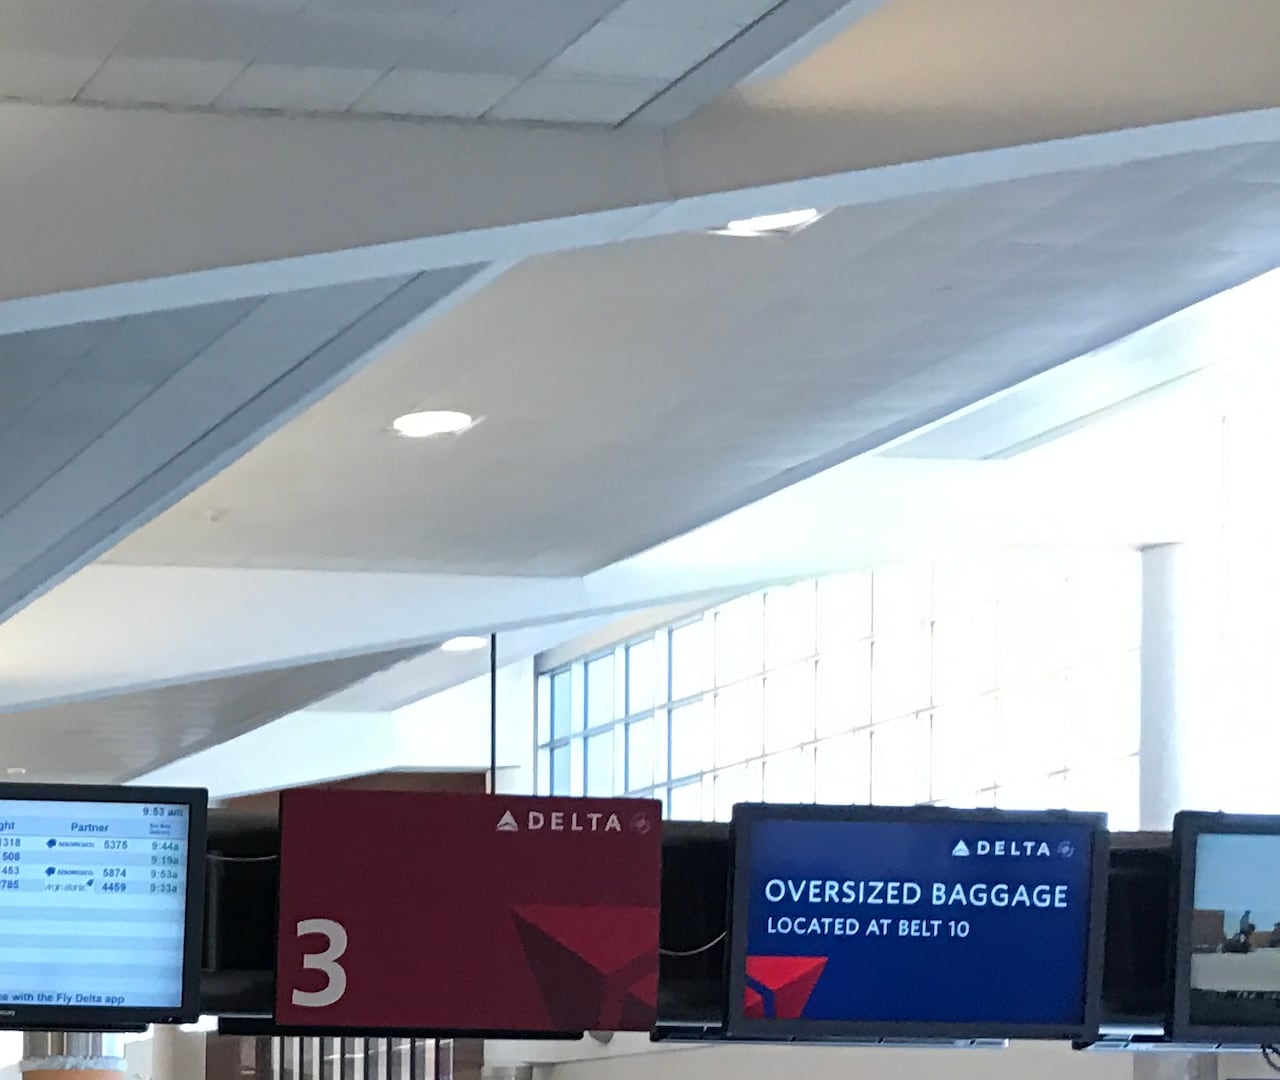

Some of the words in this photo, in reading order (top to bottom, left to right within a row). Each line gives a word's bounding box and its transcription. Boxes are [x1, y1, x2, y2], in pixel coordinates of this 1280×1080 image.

[71, 823, 109, 832] Partner
[528, 811, 622, 833] DELTA
[977, 840, 1051, 857] DELTA
[765, 879, 921, 905] OVERSIZED
[932, 883, 1068, 908] BAGGAGE
[767, 916, 859, 936] LOCATED
[865, 919, 892, 936] AT
[898, 919, 942, 937] BELT
[948, 920, 970, 937] 10
[292, 917, 348, 1008] 3
[12, 992, 33, 1001] with
[37, 992, 53, 1002] the
[57, 993, 72, 1004] Fly
[75, 993, 102, 1004] Delta
[105, 995, 124, 1005] app
